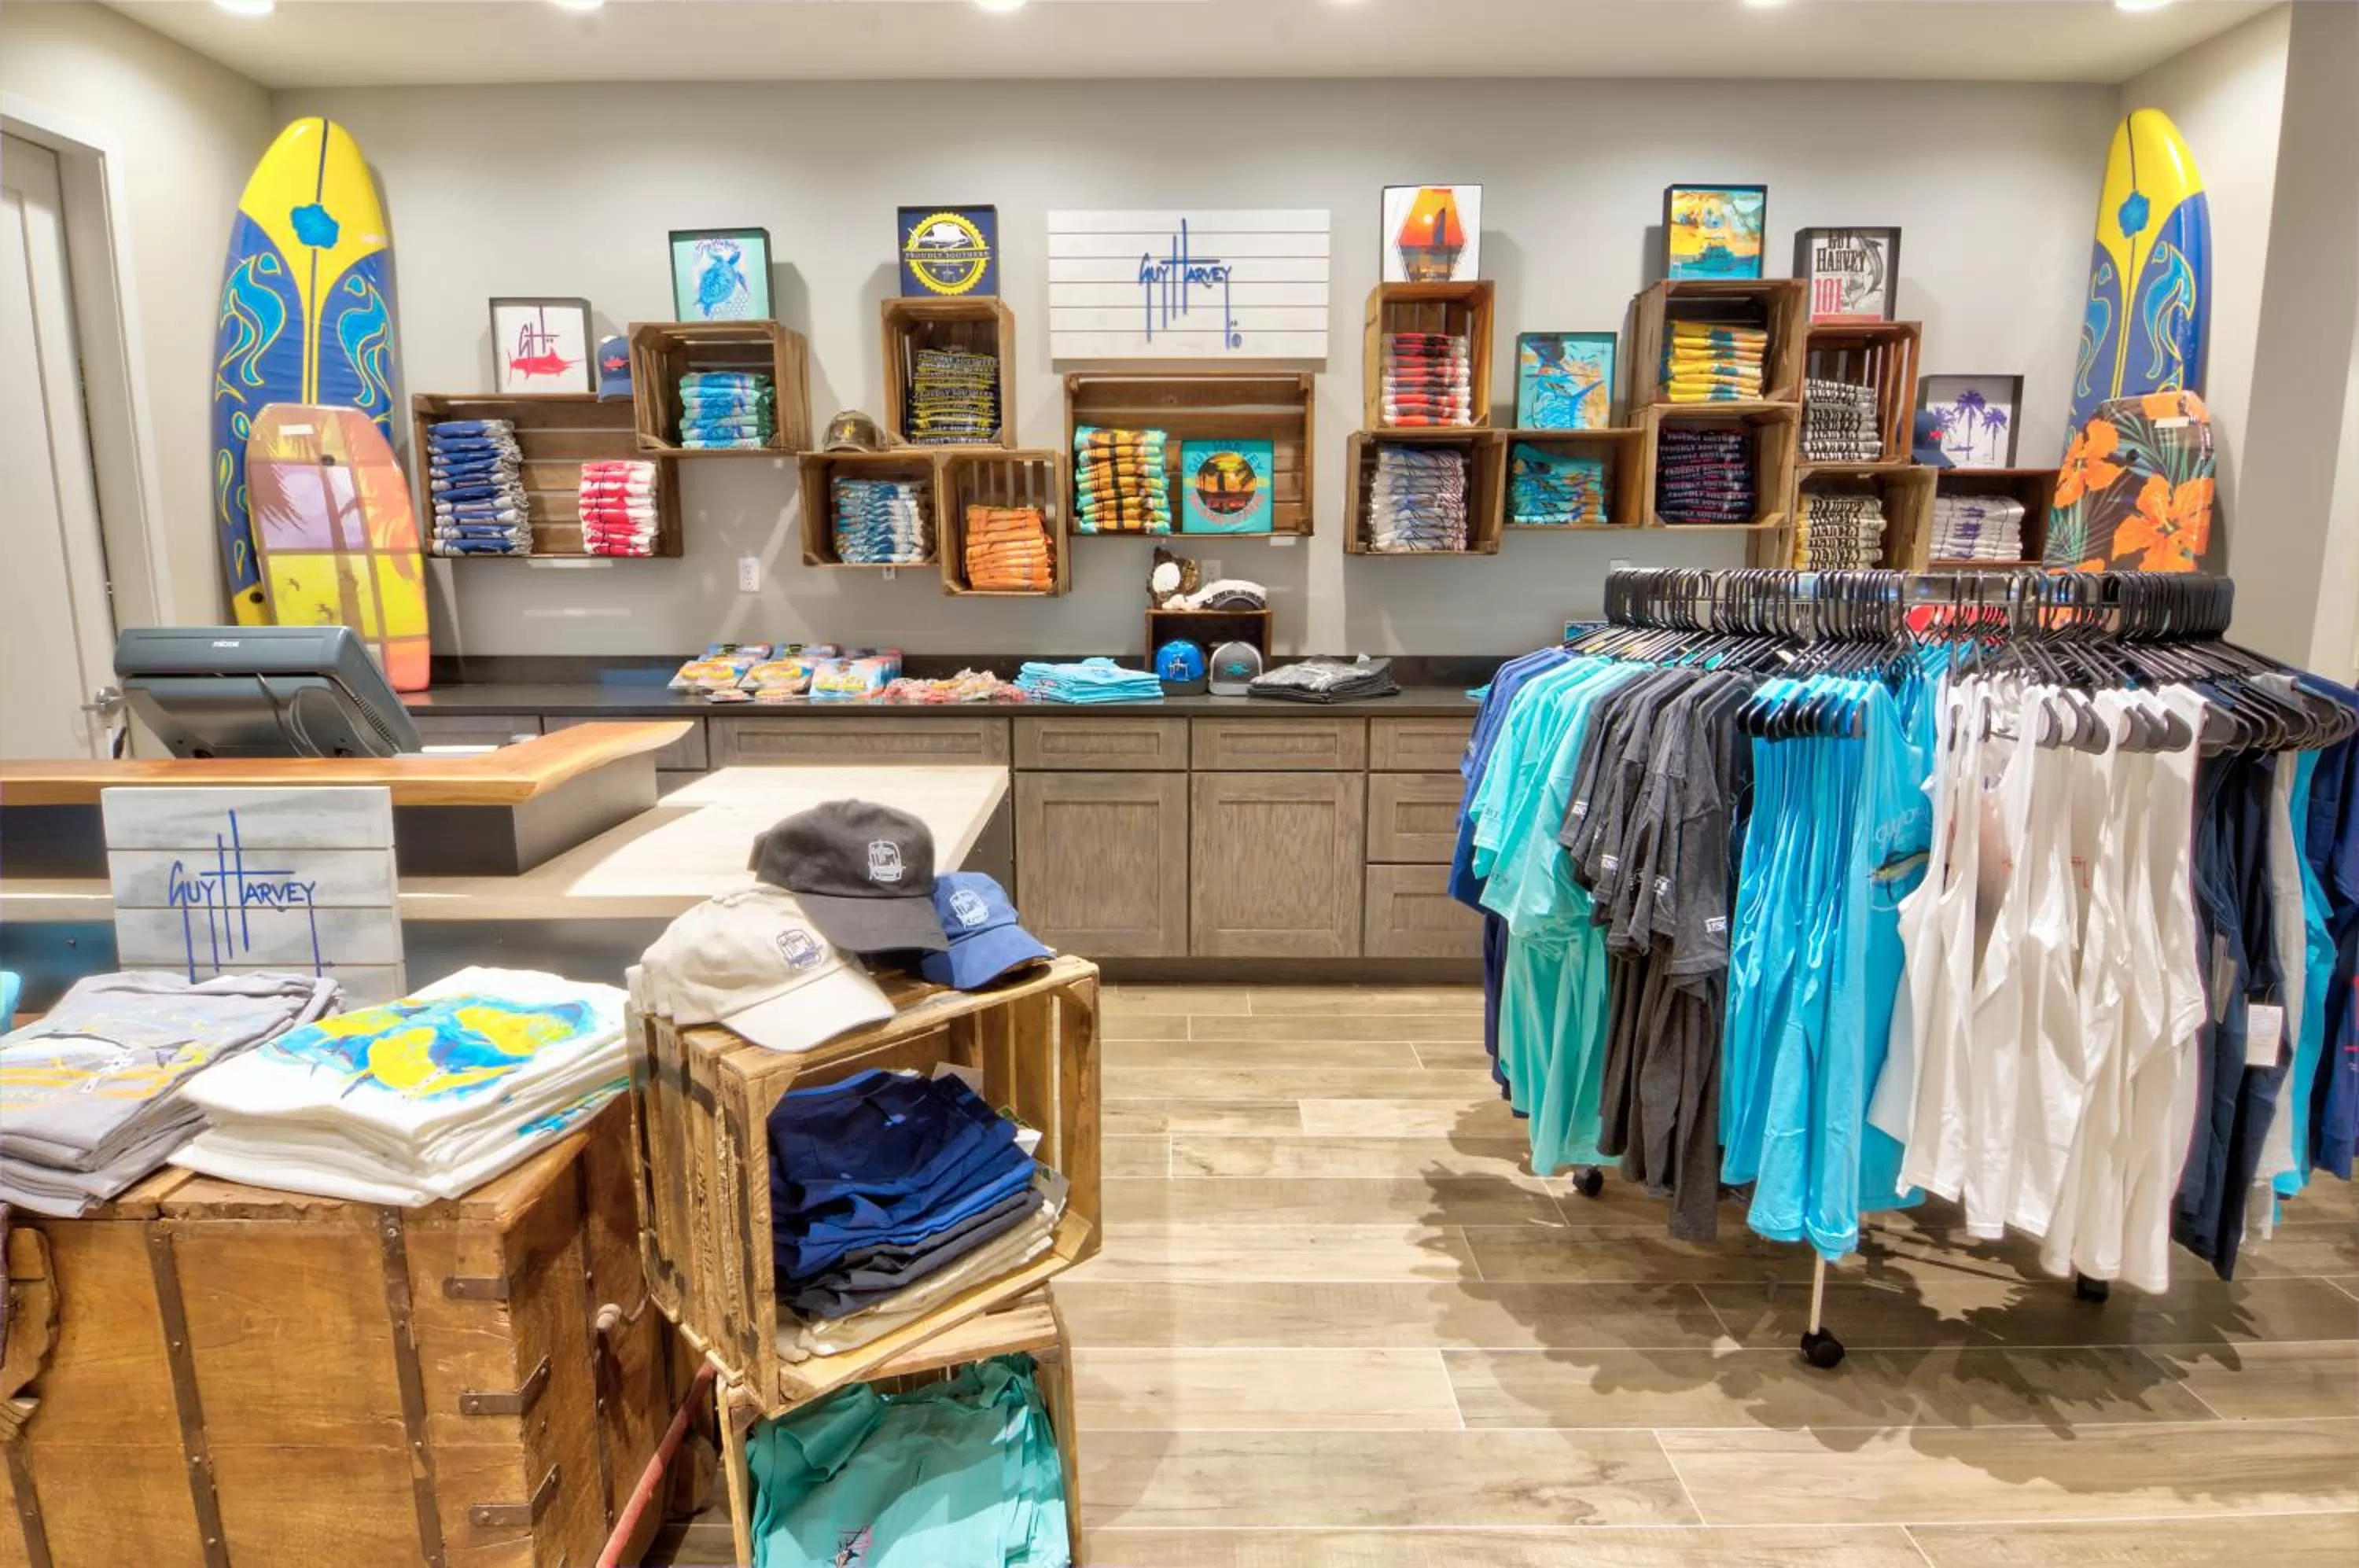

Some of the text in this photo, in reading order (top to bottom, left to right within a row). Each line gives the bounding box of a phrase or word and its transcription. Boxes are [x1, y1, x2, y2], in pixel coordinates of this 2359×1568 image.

[1159, 217, 1232, 352] HARVEY
[1816, 248, 1868, 272] HARVEY
[200, 808, 322, 979] HARVEY
